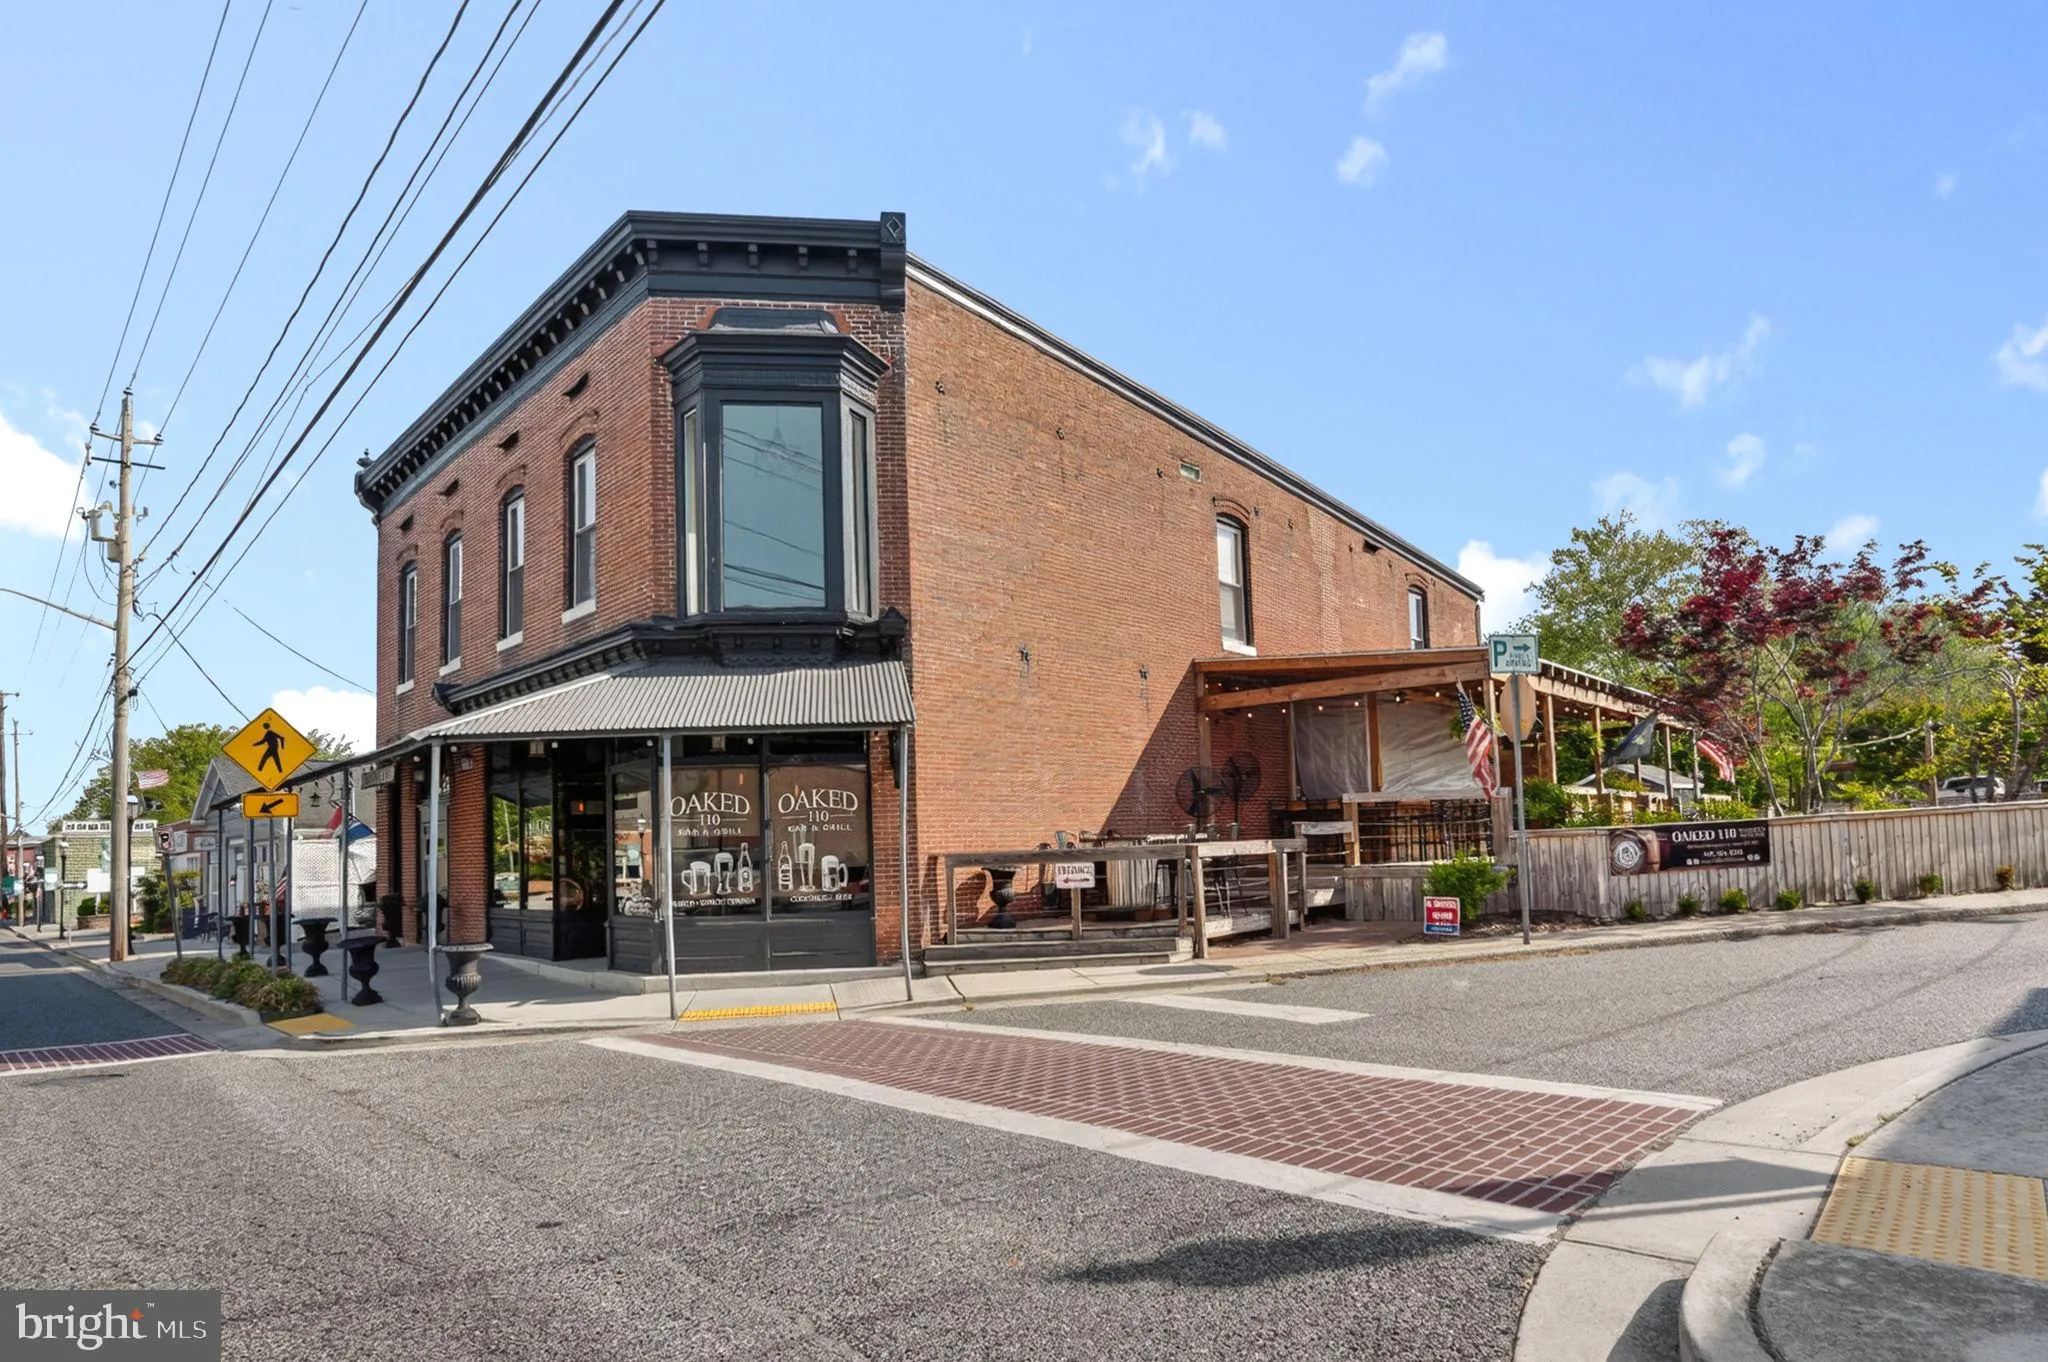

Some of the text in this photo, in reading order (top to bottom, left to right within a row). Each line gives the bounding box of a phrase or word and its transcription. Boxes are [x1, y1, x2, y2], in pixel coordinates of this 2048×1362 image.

[1493, 640, 1507, 667] P
[670, 792, 751, 817] OAKED
[778, 789, 858, 813] OAKED
[700, 814, 720, 825] 110
[809, 810, 829, 822] 110
[1672, 830, 1715, 842] OAKED
[1718, 828, 1736, 839] 110
